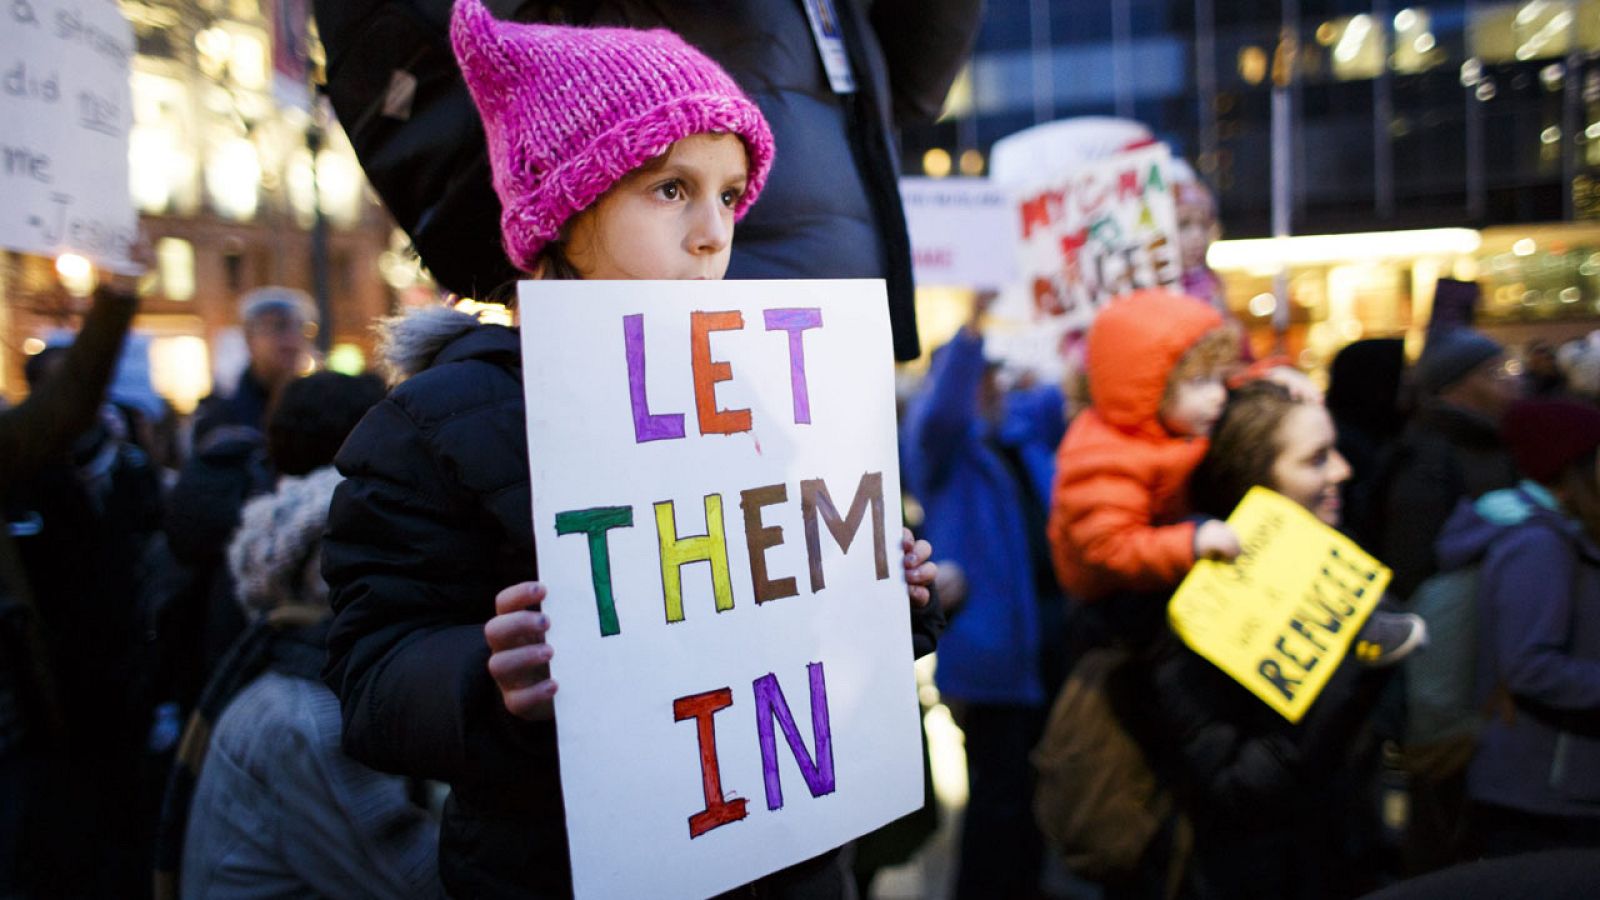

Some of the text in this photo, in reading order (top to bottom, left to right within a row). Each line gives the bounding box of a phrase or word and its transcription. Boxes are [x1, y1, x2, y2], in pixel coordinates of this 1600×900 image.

[623, 307, 824, 444] LET
[555, 471, 890, 638] THEM
[673, 661, 836, 840] IN
